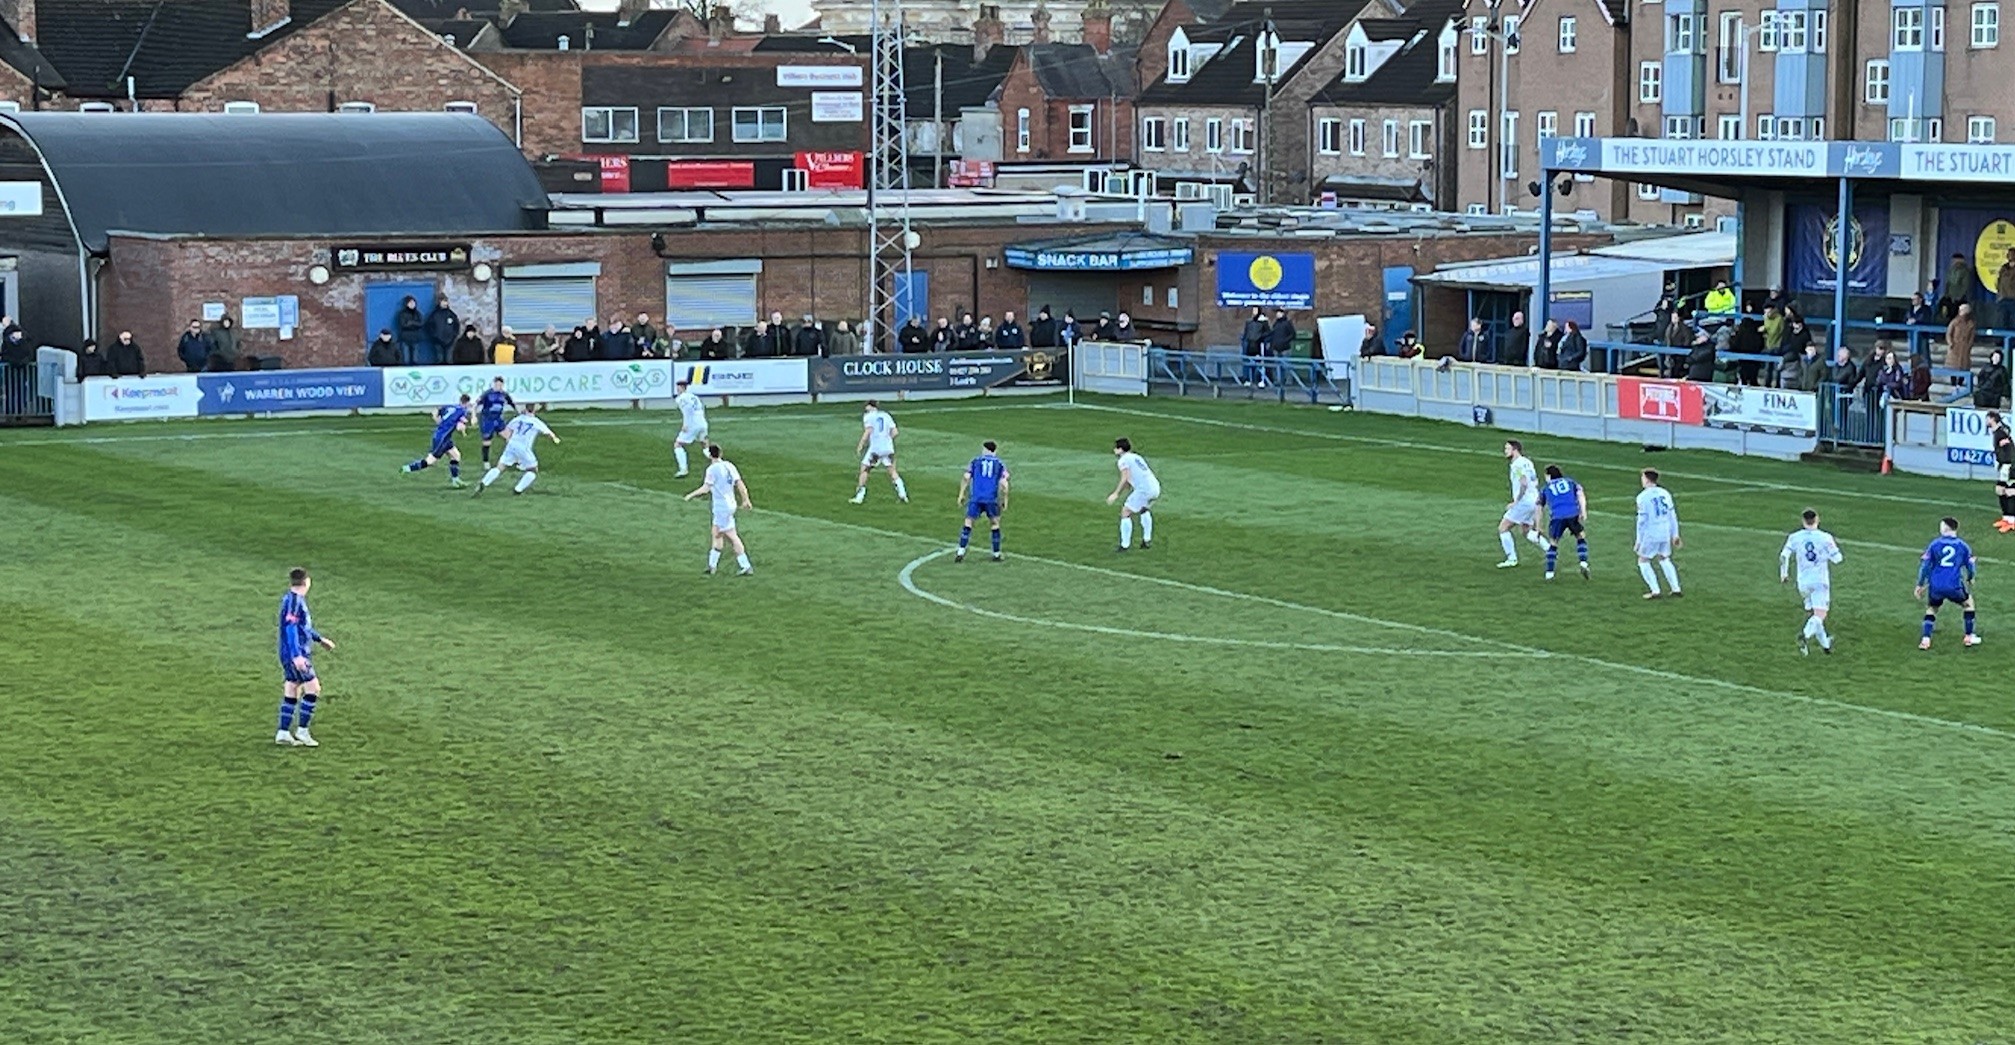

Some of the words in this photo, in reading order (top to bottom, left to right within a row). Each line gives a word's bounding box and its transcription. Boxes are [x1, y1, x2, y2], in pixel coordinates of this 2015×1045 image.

[1613, 145, 1641, 165] THE
[1643, 146, 1695, 167] STUART
[1698, 147, 1764, 168] HORSLEY
[1767, 149, 1816, 169] STAND
[1915, 151, 1946, 172] THE
[1949, 152, 2012, 174] STUART
[364, 252, 383, 263] THE
[421, 252, 447, 262] CLUB
[1037, 253, 1087, 267] SNACK
[1089, 254, 1118, 267] BAR
[843, 361, 892, 376] CLOCK
[896, 359, 944, 374] HOUSE
[122, 386, 179, 398] Keepmoat
[245, 386, 294, 400] WARREN
[296, 385, 335, 399] WOOD
[336, 384, 367, 397] VIEW
[457, 374, 603, 395] GRUNDCARE
[1763, 392, 1798, 410] FINA
[981, 459, 994, 479] 11
[1549, 480, 1571, 497] 10
[1804, 541, 1817, 562] 8
[1940, 545, 1956, 567] 2
